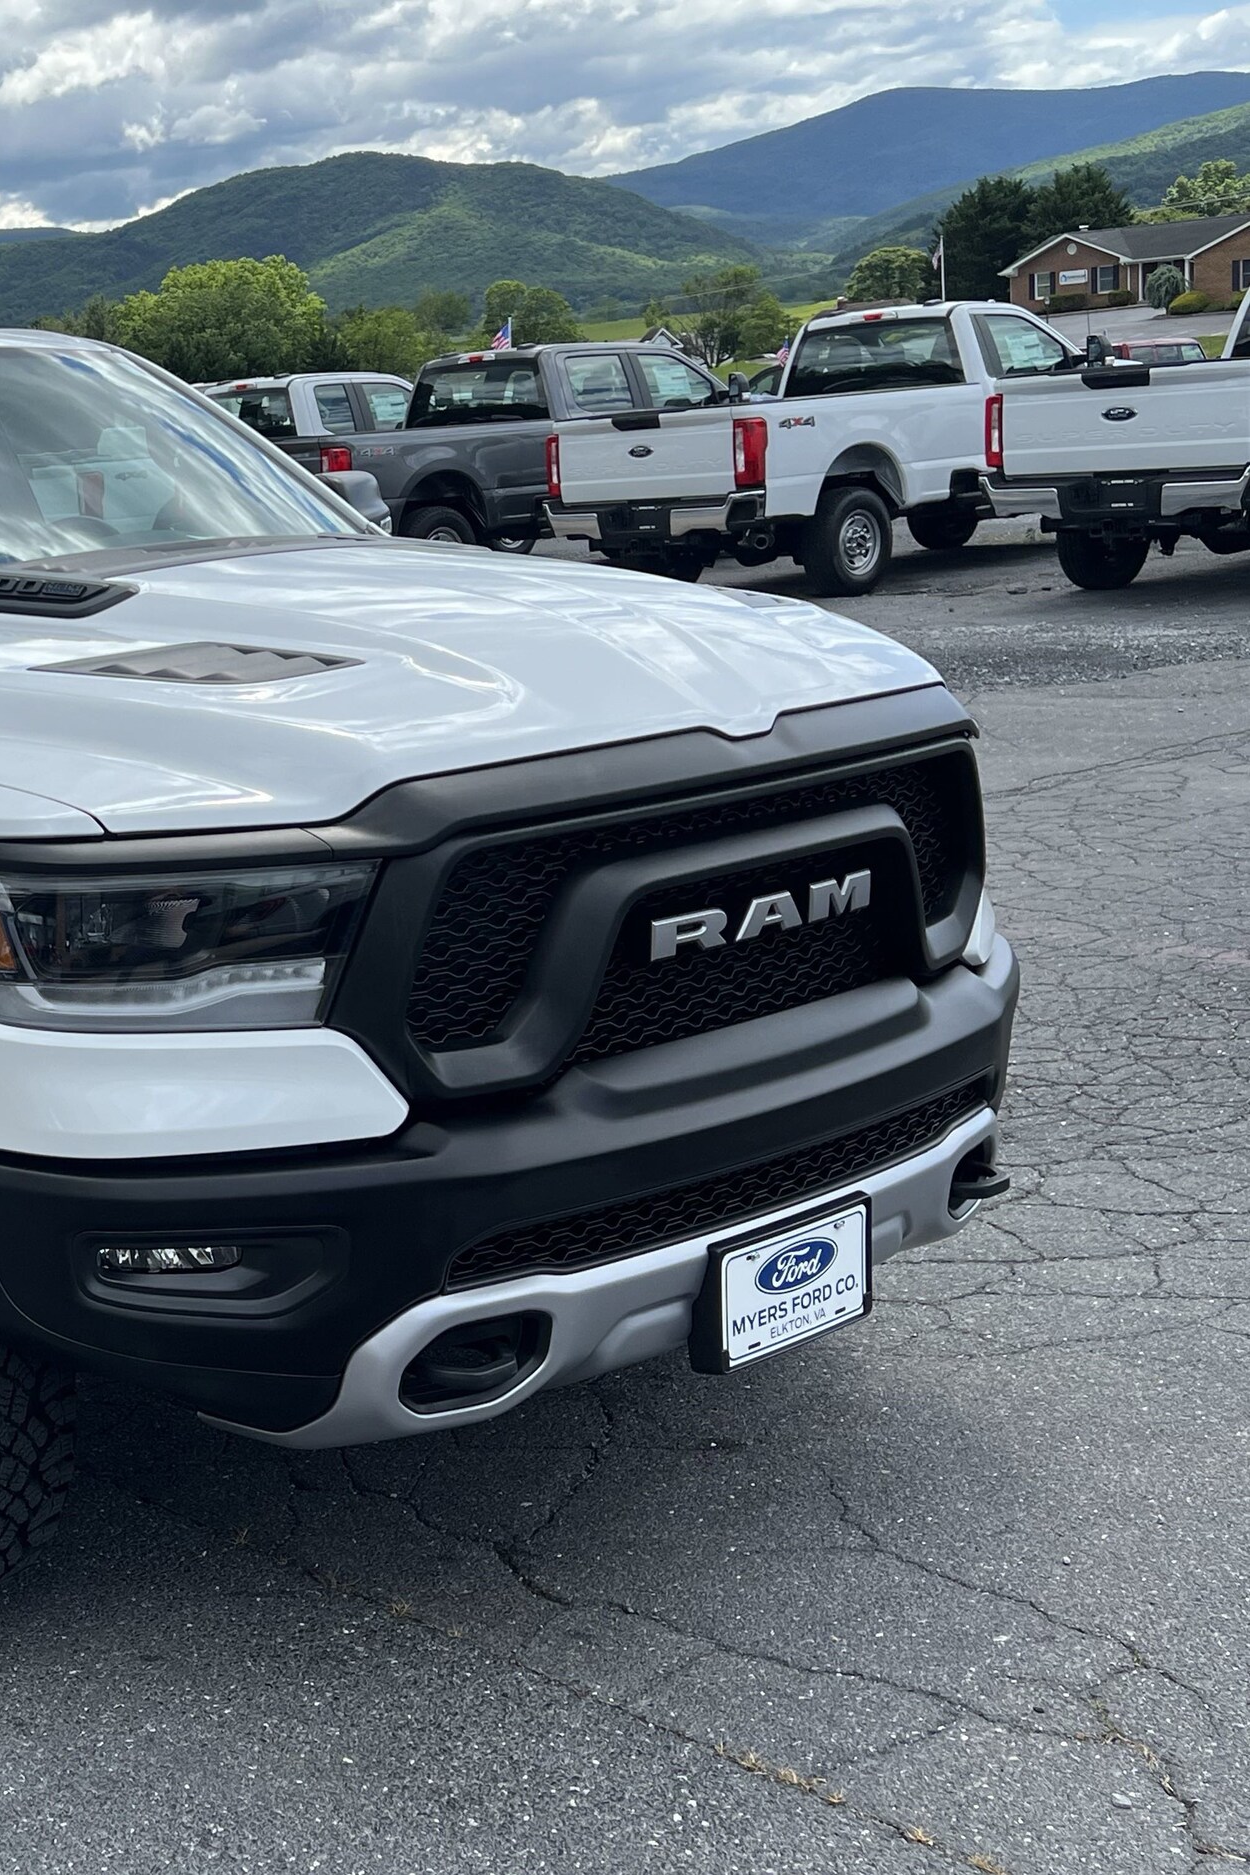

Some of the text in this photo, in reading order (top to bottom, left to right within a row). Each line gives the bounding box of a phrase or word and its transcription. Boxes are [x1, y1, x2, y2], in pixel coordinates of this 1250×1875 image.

[651, 868, 871, 962] RAM
[772, 1246, 824, 1288] Ford
[732, 1274, 859, 1337] MYERS FORD CO.
[770, 1307, 827, 1339] ELKTON, VA
